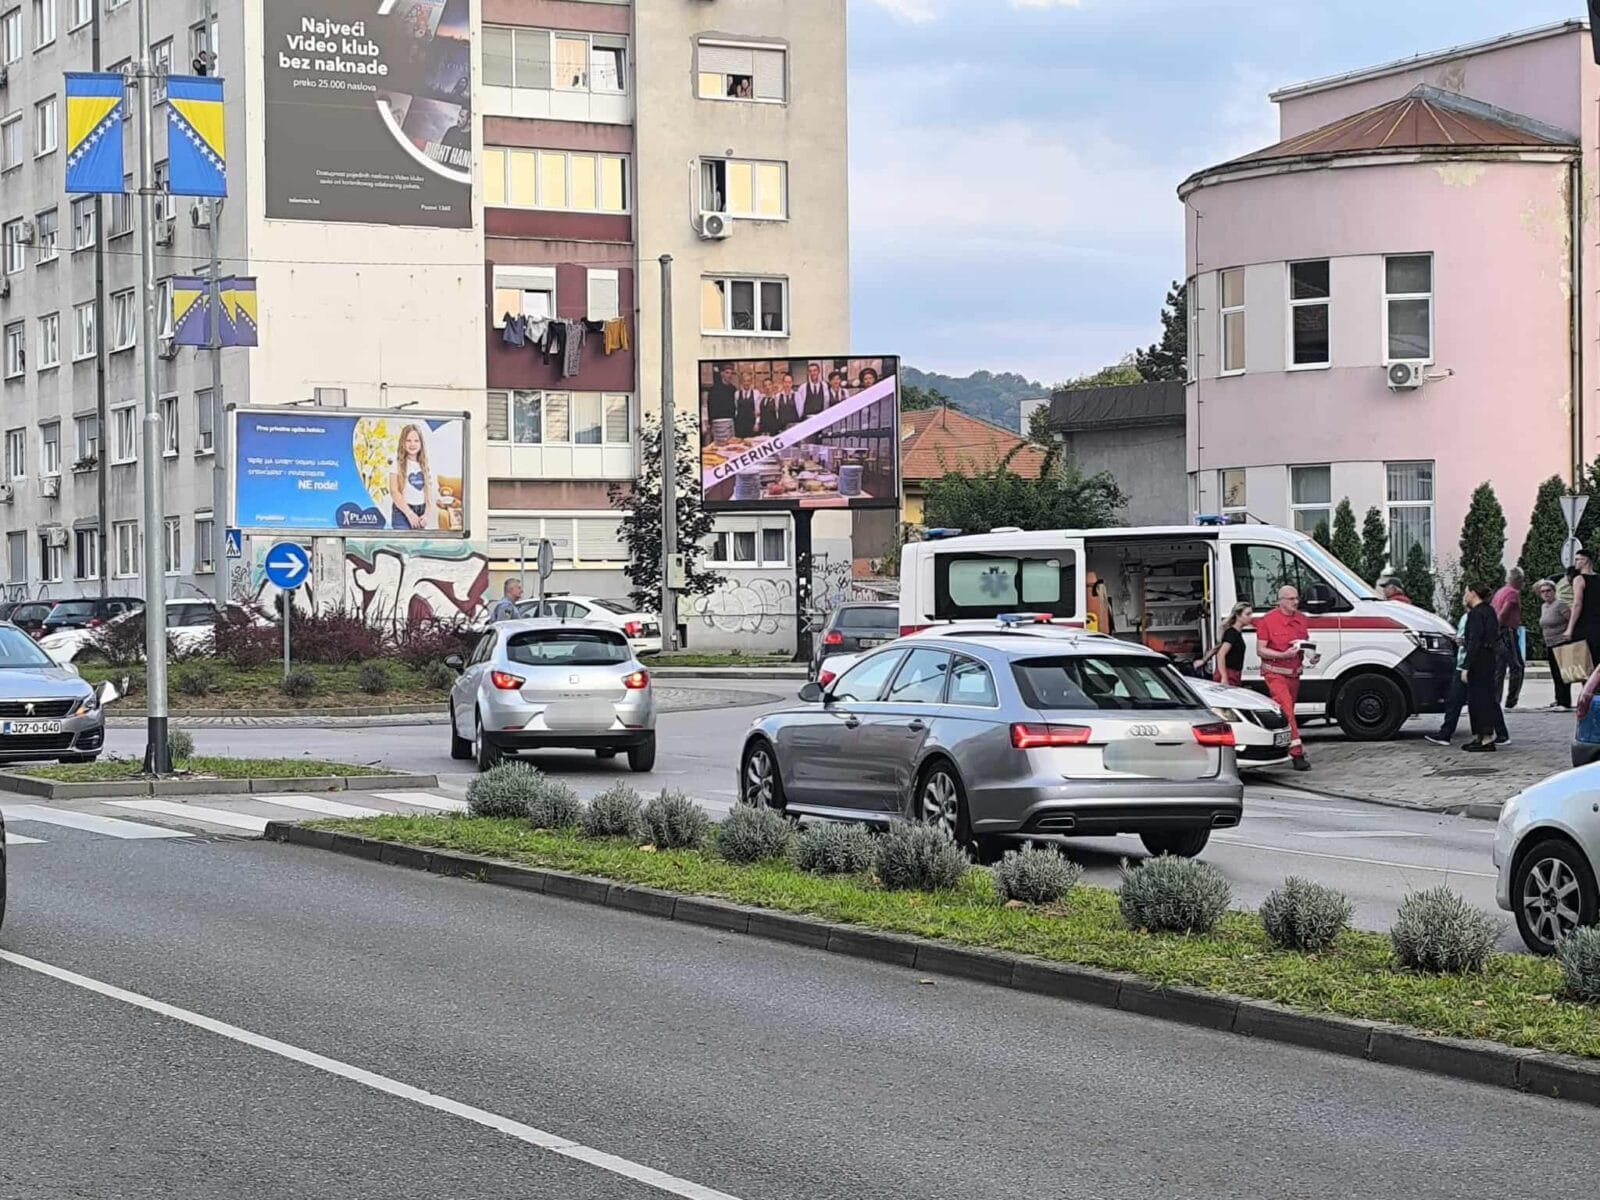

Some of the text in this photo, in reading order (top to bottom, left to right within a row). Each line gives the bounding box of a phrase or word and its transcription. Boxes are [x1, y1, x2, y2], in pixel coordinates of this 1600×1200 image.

[301, 17, 365, 38] Najveći
[286, 35, 380, 57] Video klub
[278, 53, 388, 75] bez naknade
[293, 78, 377, 92] preko 25.000 naslova
[713, 437, 785, 480] CATERING
[298, 480, 313, 490] NE
[350, 512, 378, 521] PLAVA
